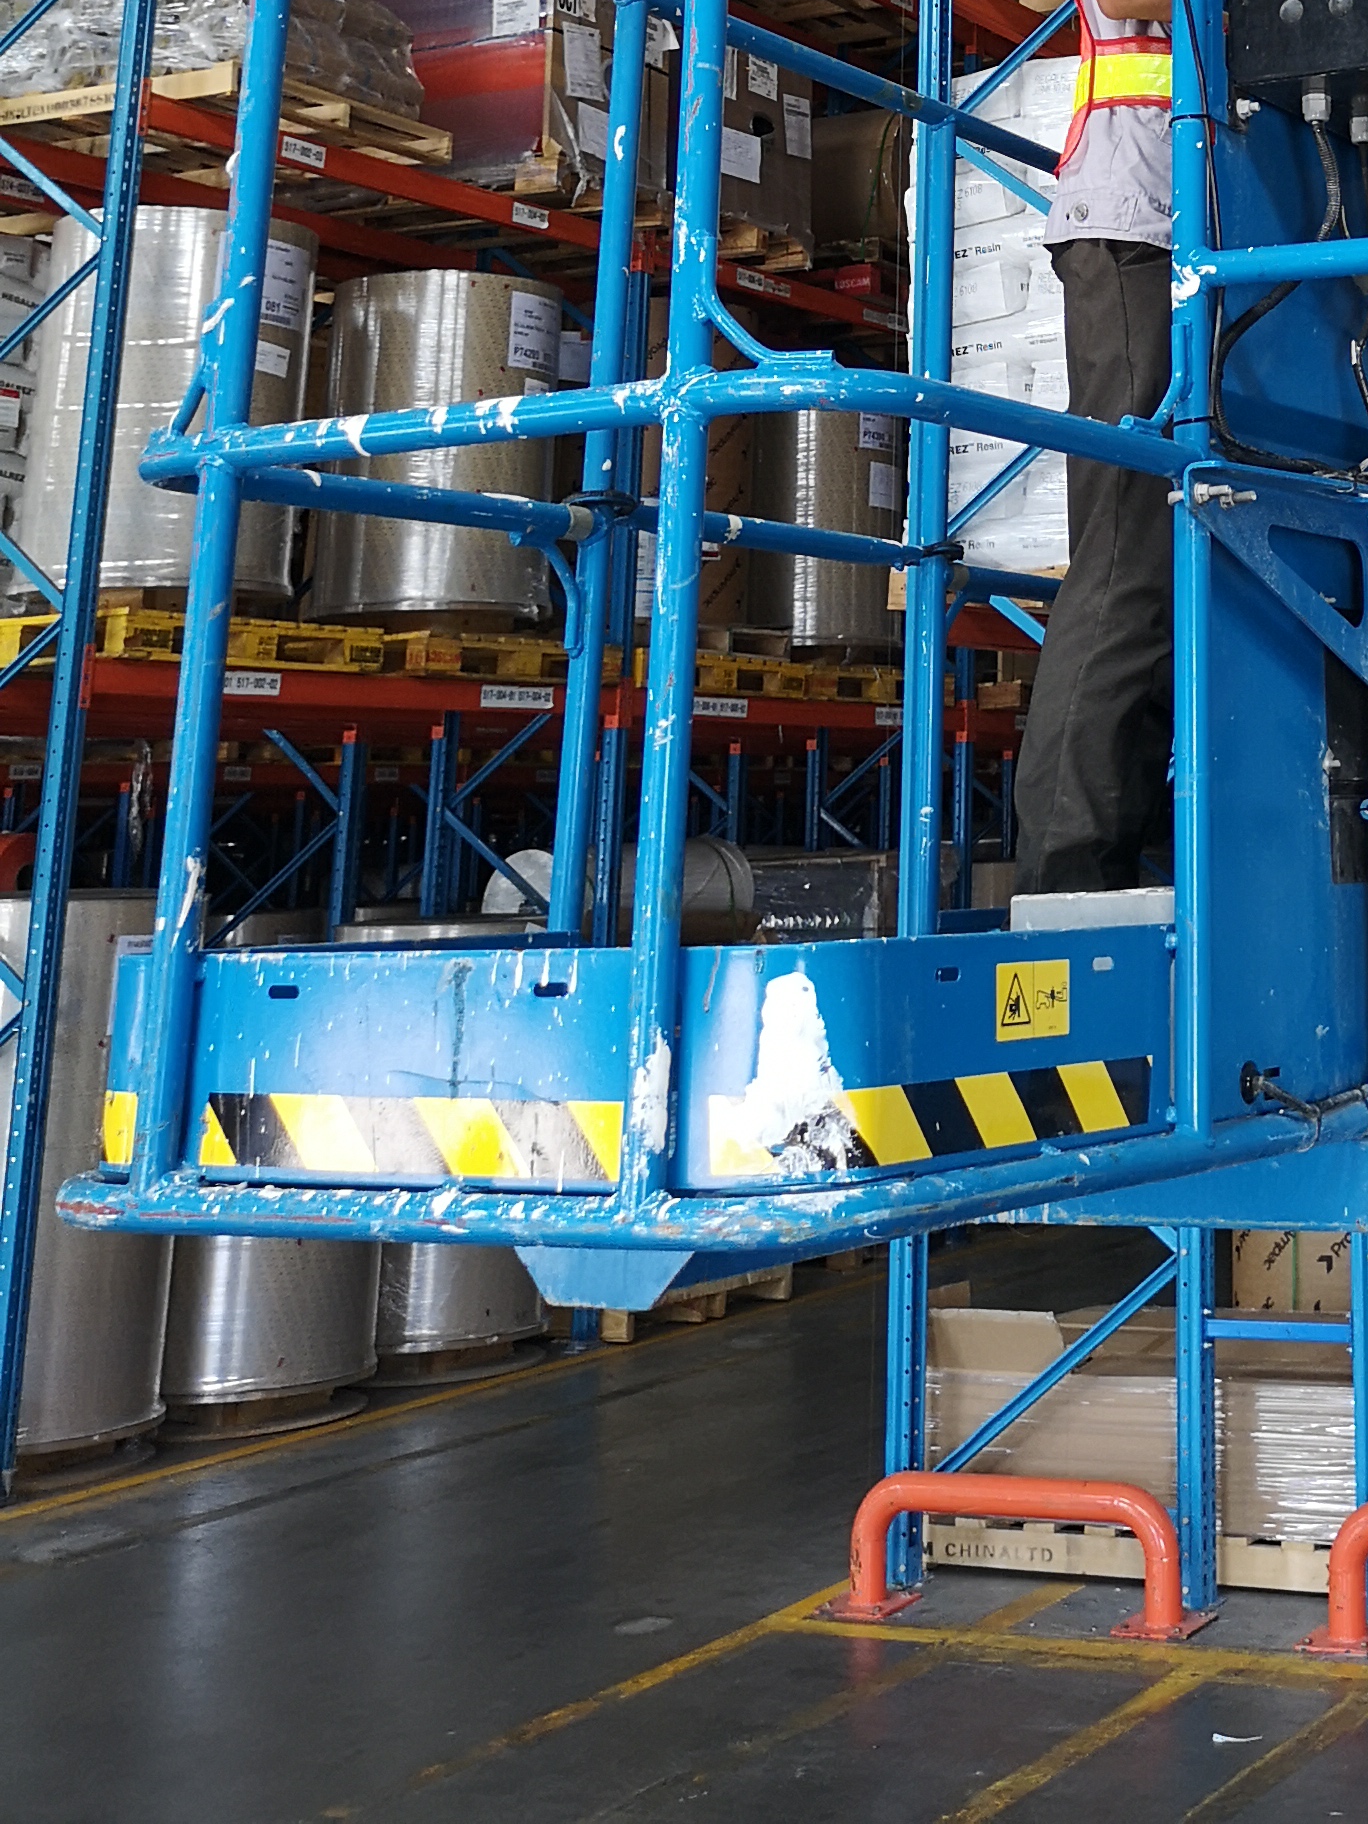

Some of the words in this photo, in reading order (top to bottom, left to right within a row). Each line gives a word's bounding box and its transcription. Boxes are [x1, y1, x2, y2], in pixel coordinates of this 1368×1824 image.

[975, 243, 1001, 257] Resin
[976, 340, 1003, 354] Resin
[976, 440, 1004, 454] Resin
